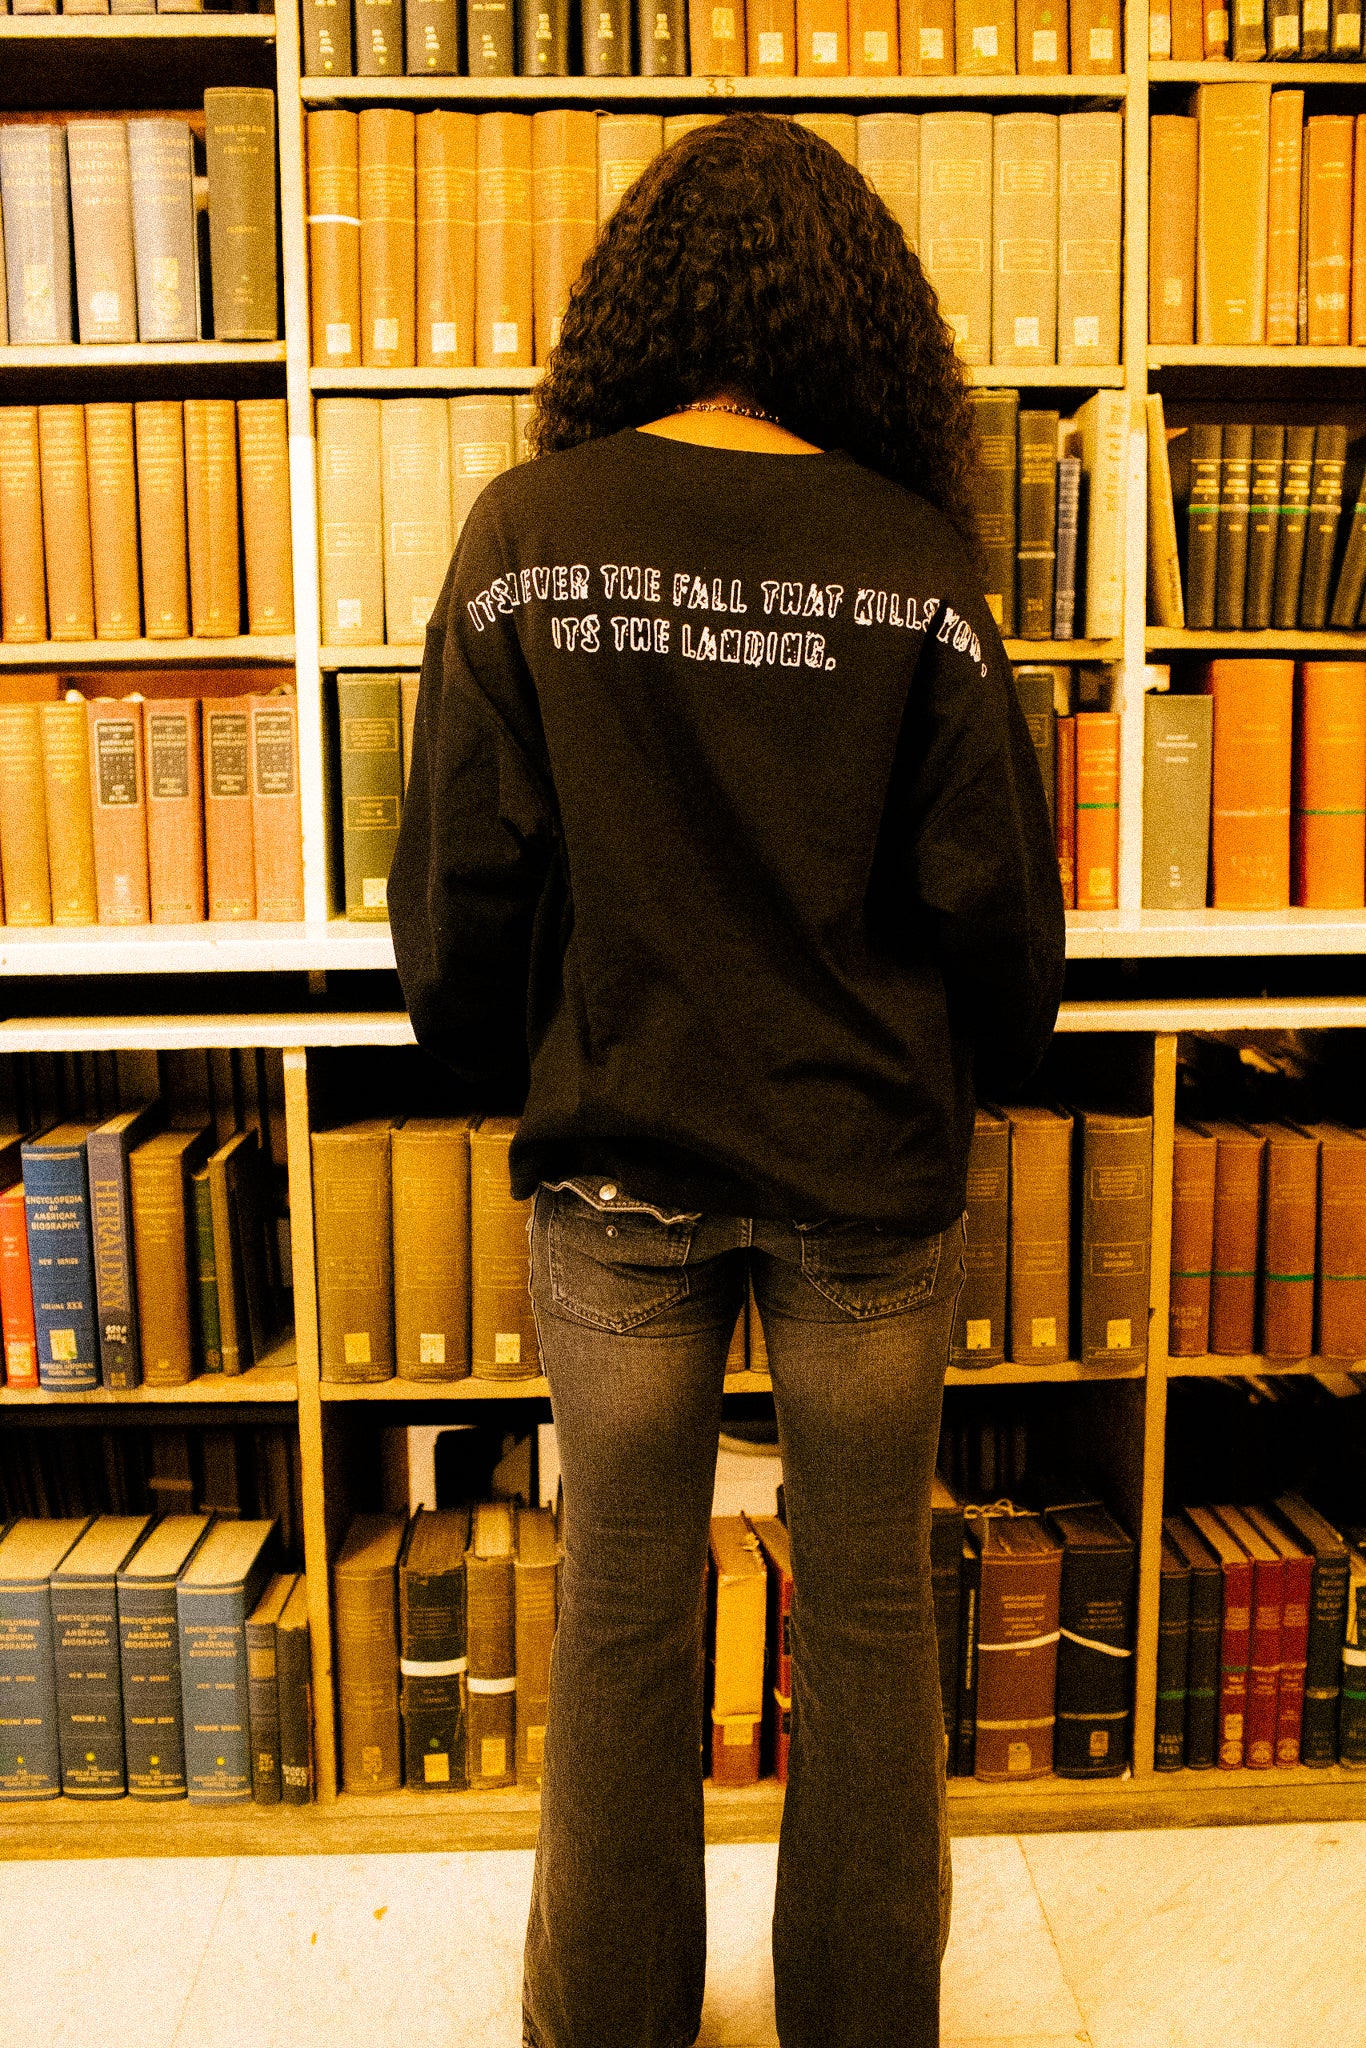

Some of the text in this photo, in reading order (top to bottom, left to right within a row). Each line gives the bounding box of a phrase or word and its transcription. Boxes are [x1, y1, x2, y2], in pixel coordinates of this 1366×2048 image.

[706, 79, 736, 96] 35
[467, 577, 514, 632] ITS
[600, 564, 661, 602] THE
[673, 573, 748, 614] FALL
[760, 580, 845, 619] THAT
[854, 587, 941, 633] KILLS
[551, 613, 837, 671] ITS THE LANDING.
[26, 1195, 83, 1205] ENCYCLOPEDIA
[34, 1212, 77, 1221] AMERICAN
[31, 1222, 81, 1231] BIOGRAPHY
[95, 1180, 126, 1310] HERALDRY
[41, 1303, 64, 1311] VOLUME
